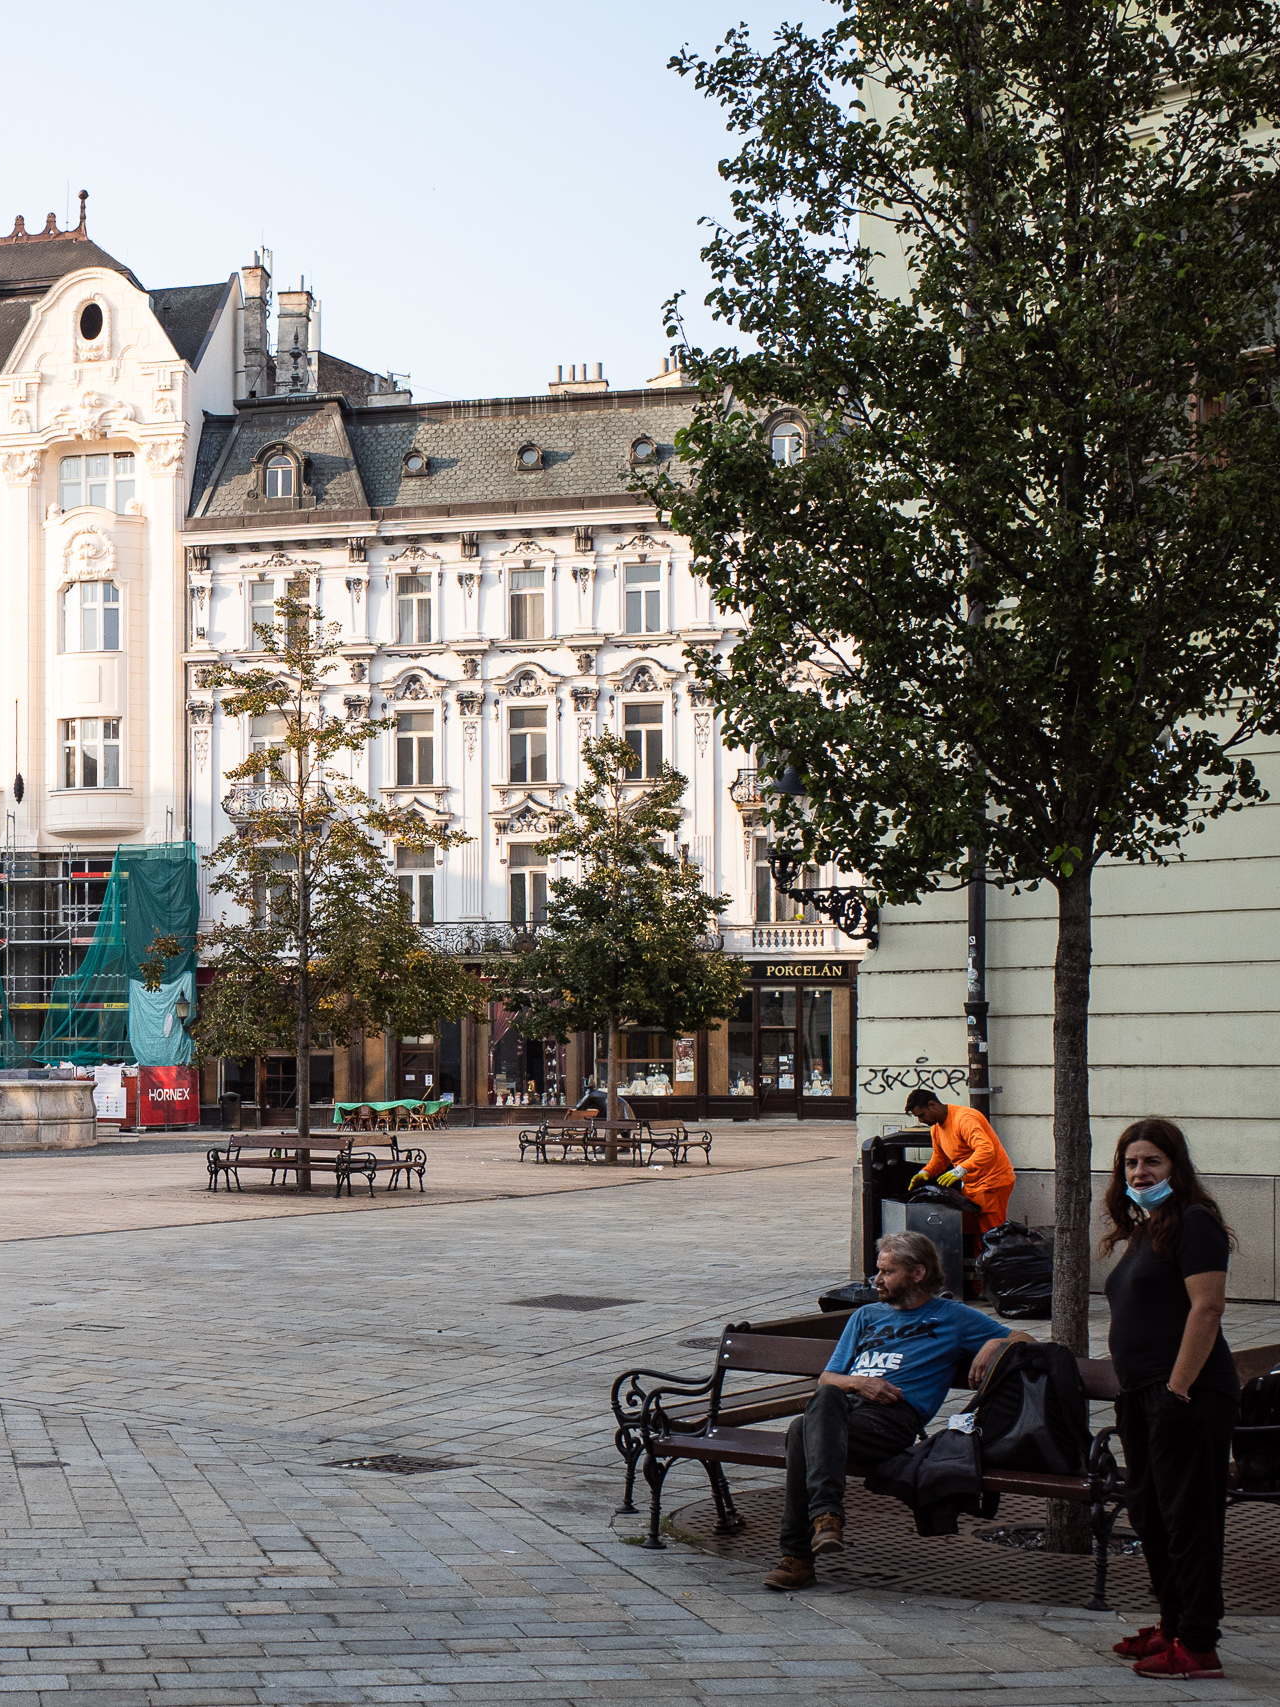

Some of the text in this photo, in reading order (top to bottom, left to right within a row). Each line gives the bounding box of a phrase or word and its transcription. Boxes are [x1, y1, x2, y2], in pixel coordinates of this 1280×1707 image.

[766, 963, 843, 977] PORCELÁN
[148, 1087, 190, 1102] HORNEX
[851, 1351, 904, 1370] AKE
